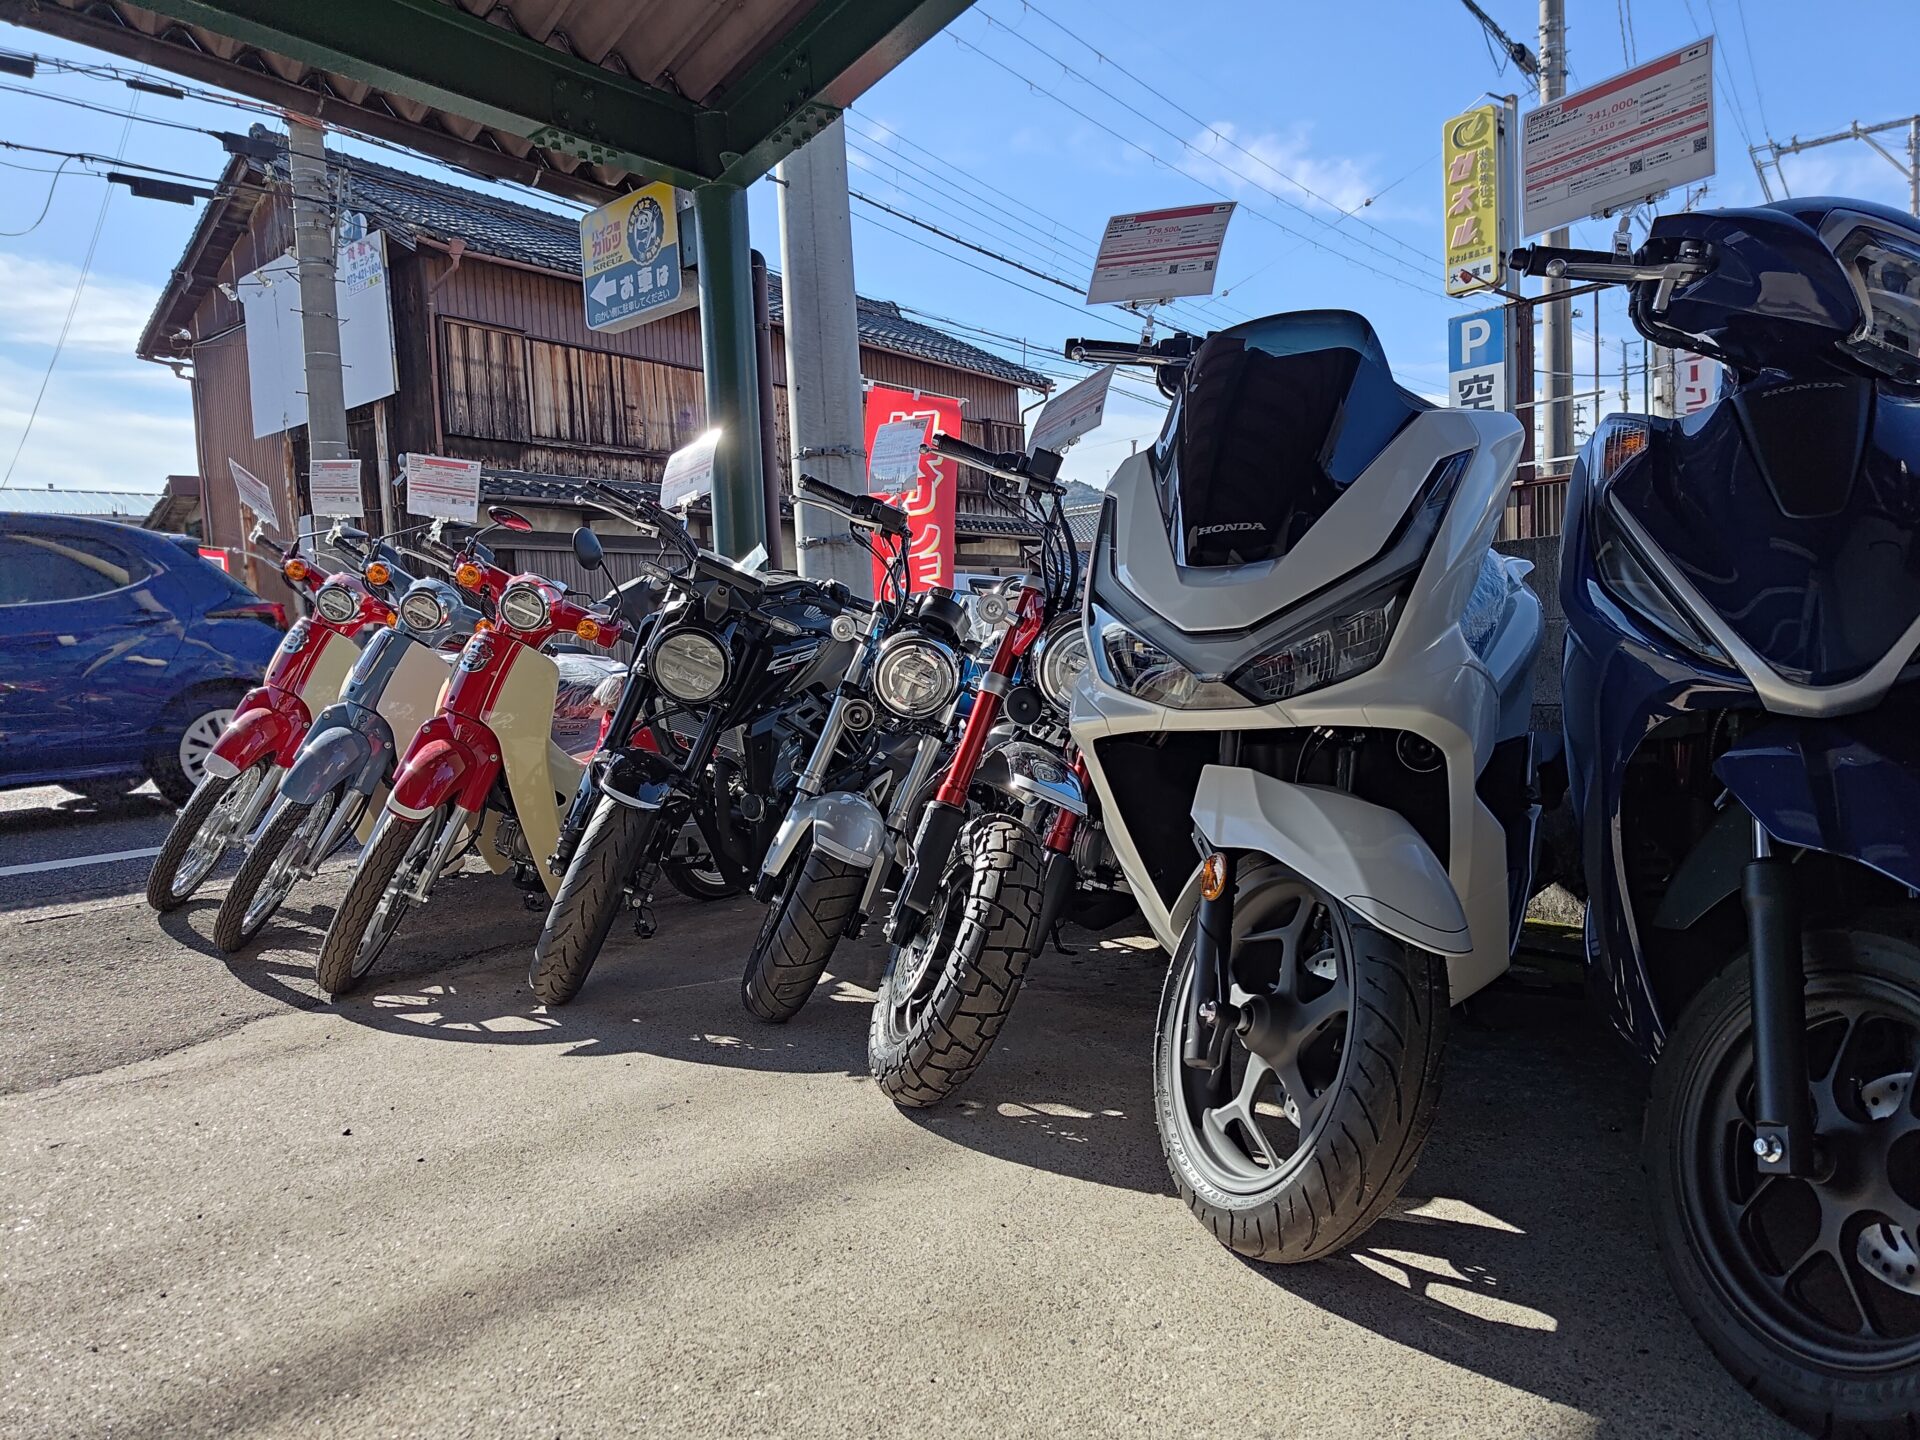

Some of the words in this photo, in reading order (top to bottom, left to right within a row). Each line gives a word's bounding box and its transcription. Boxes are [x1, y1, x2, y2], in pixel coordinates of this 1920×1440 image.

[593, 255, 624, 272] KREUZ
[1761, 382, 1847, 398] HONDA
[1197, 522, 1266, 536] HONDA
